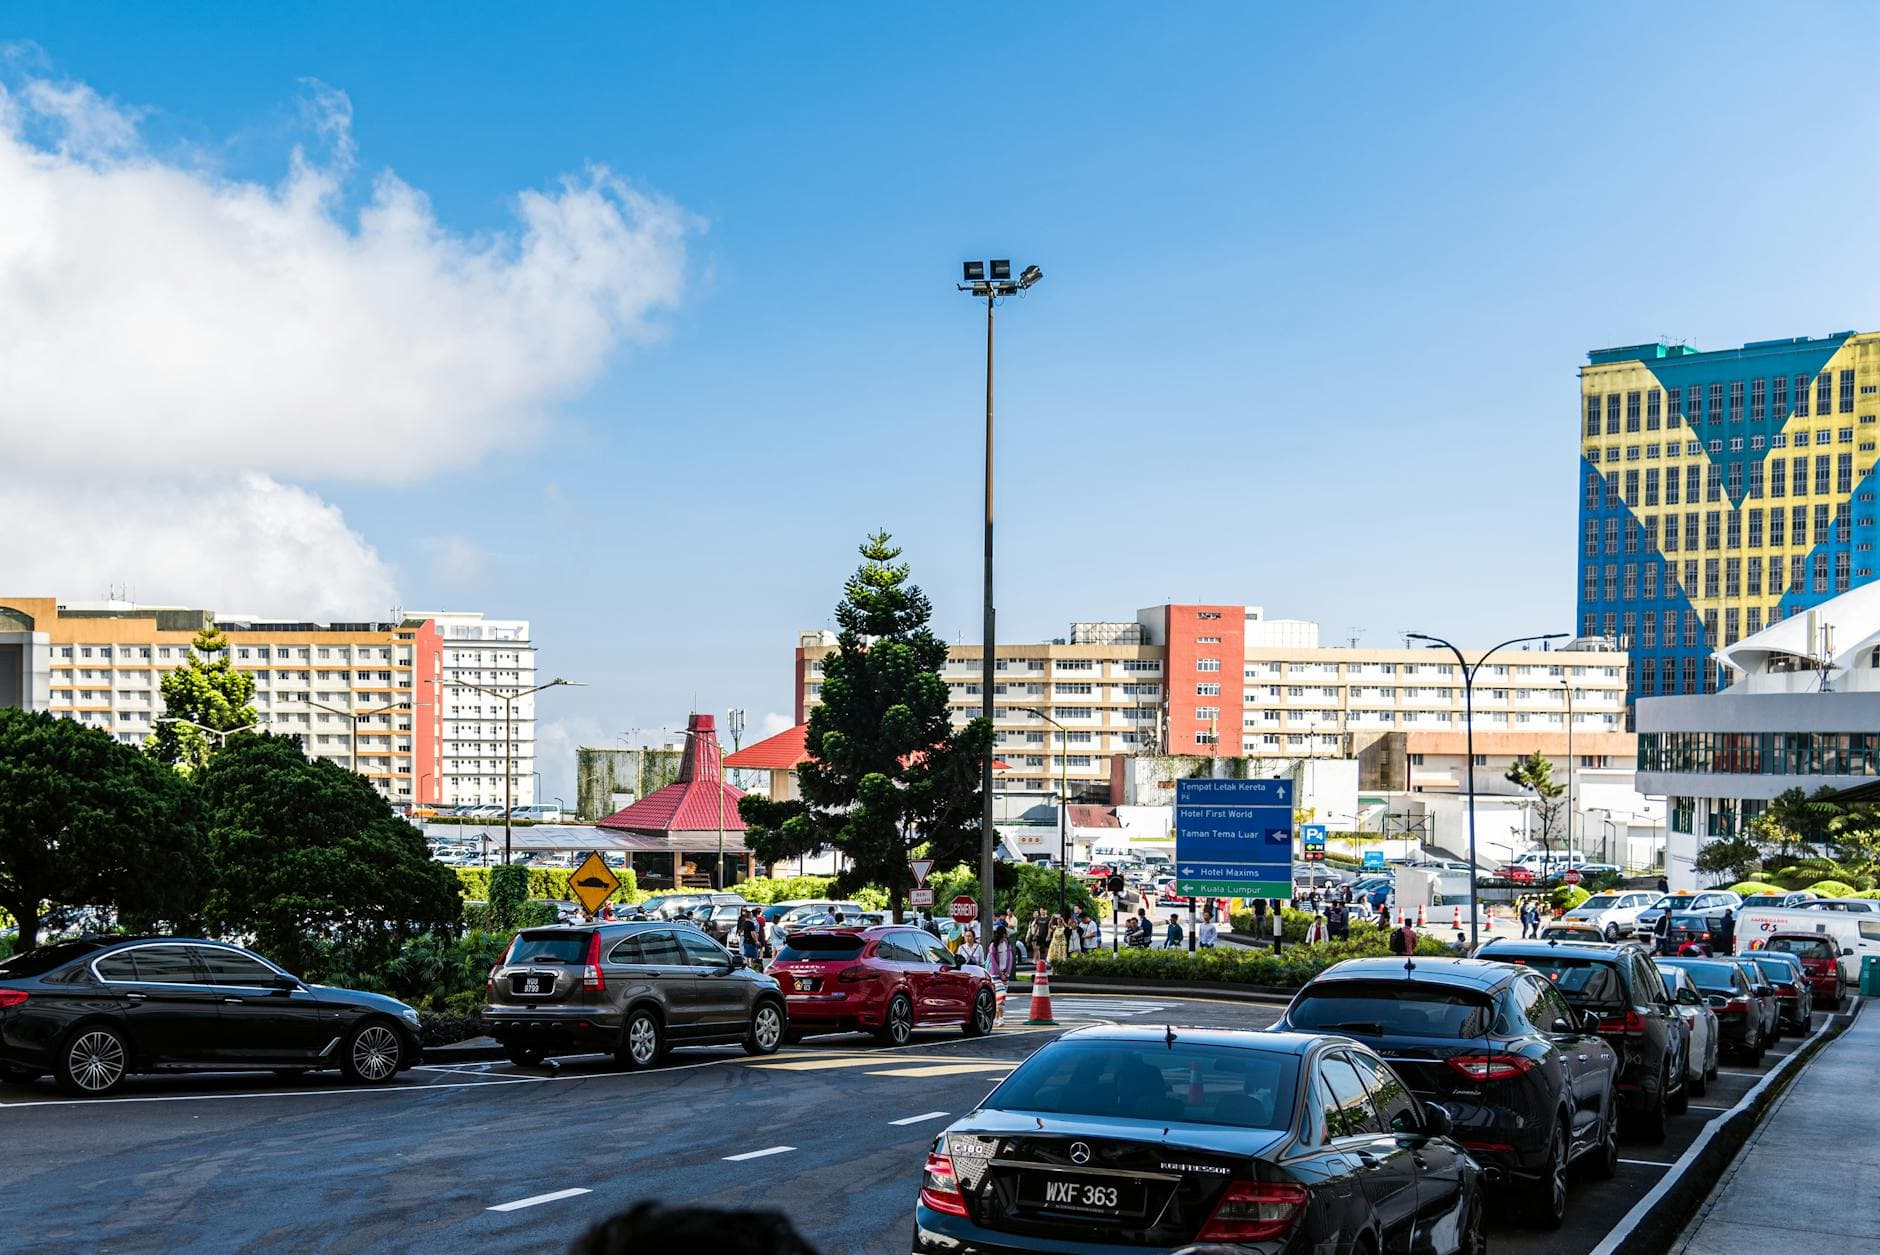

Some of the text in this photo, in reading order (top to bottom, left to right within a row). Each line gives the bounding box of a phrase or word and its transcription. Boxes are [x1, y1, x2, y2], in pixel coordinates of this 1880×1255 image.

[1181, 782, 1266, 792] Tempat Letak Kereta
[1228, 810, 1253, 818] World
[1181, 829, 1258, 839] Taman Tema Luar
[1306, 828, 1323, 840] P4
[1200, 868, 1260, 877] Hotel Maxims
[1200, 885, 1261, 894] Kuala Lumpur
[1046, 1181, 1118, 1207] WXF 363
